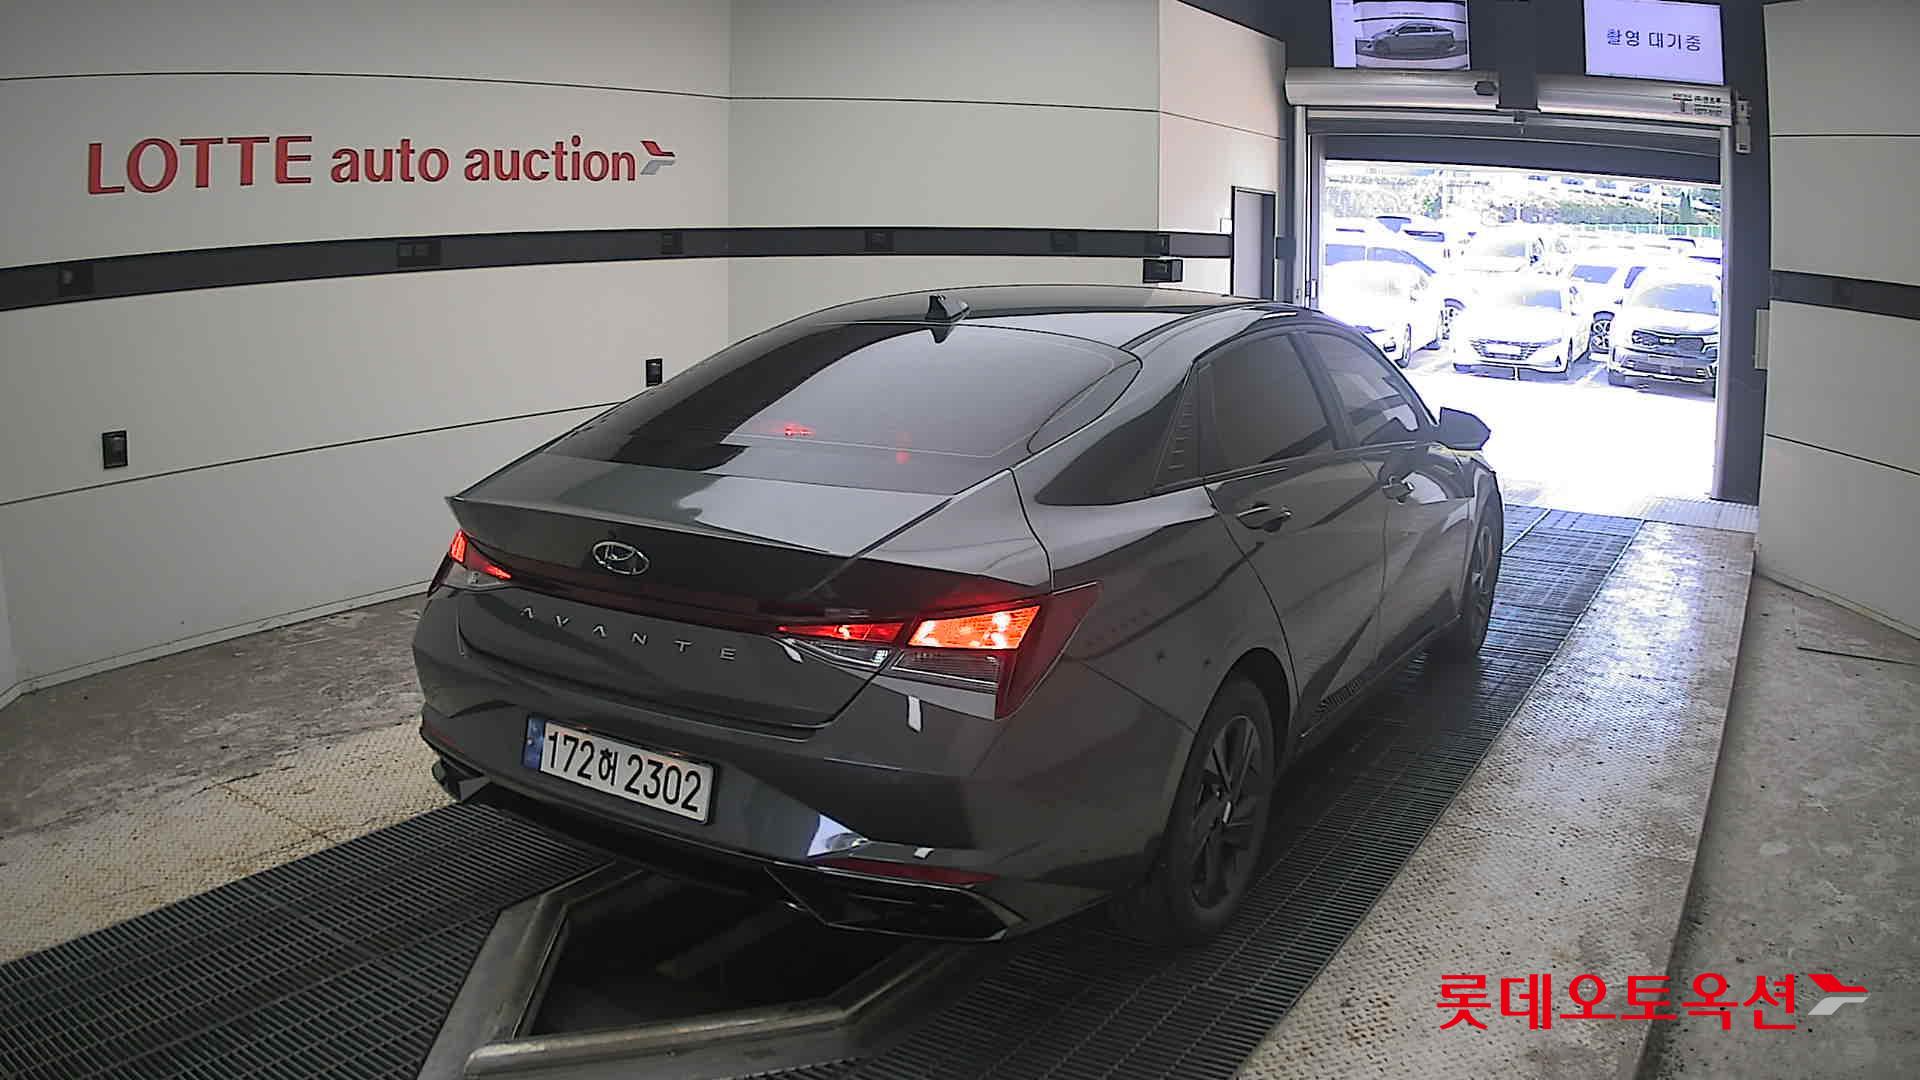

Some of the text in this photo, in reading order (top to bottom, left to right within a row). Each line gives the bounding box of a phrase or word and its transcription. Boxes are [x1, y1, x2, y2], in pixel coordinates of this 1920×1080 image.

[1648, 32, 1701, 52] 대기중
[88, 135, 637, 195] LOTTE auto auction
[520, 606, 737, 660] AVANTE
[548, 731, 702, 813] 172허 2302
